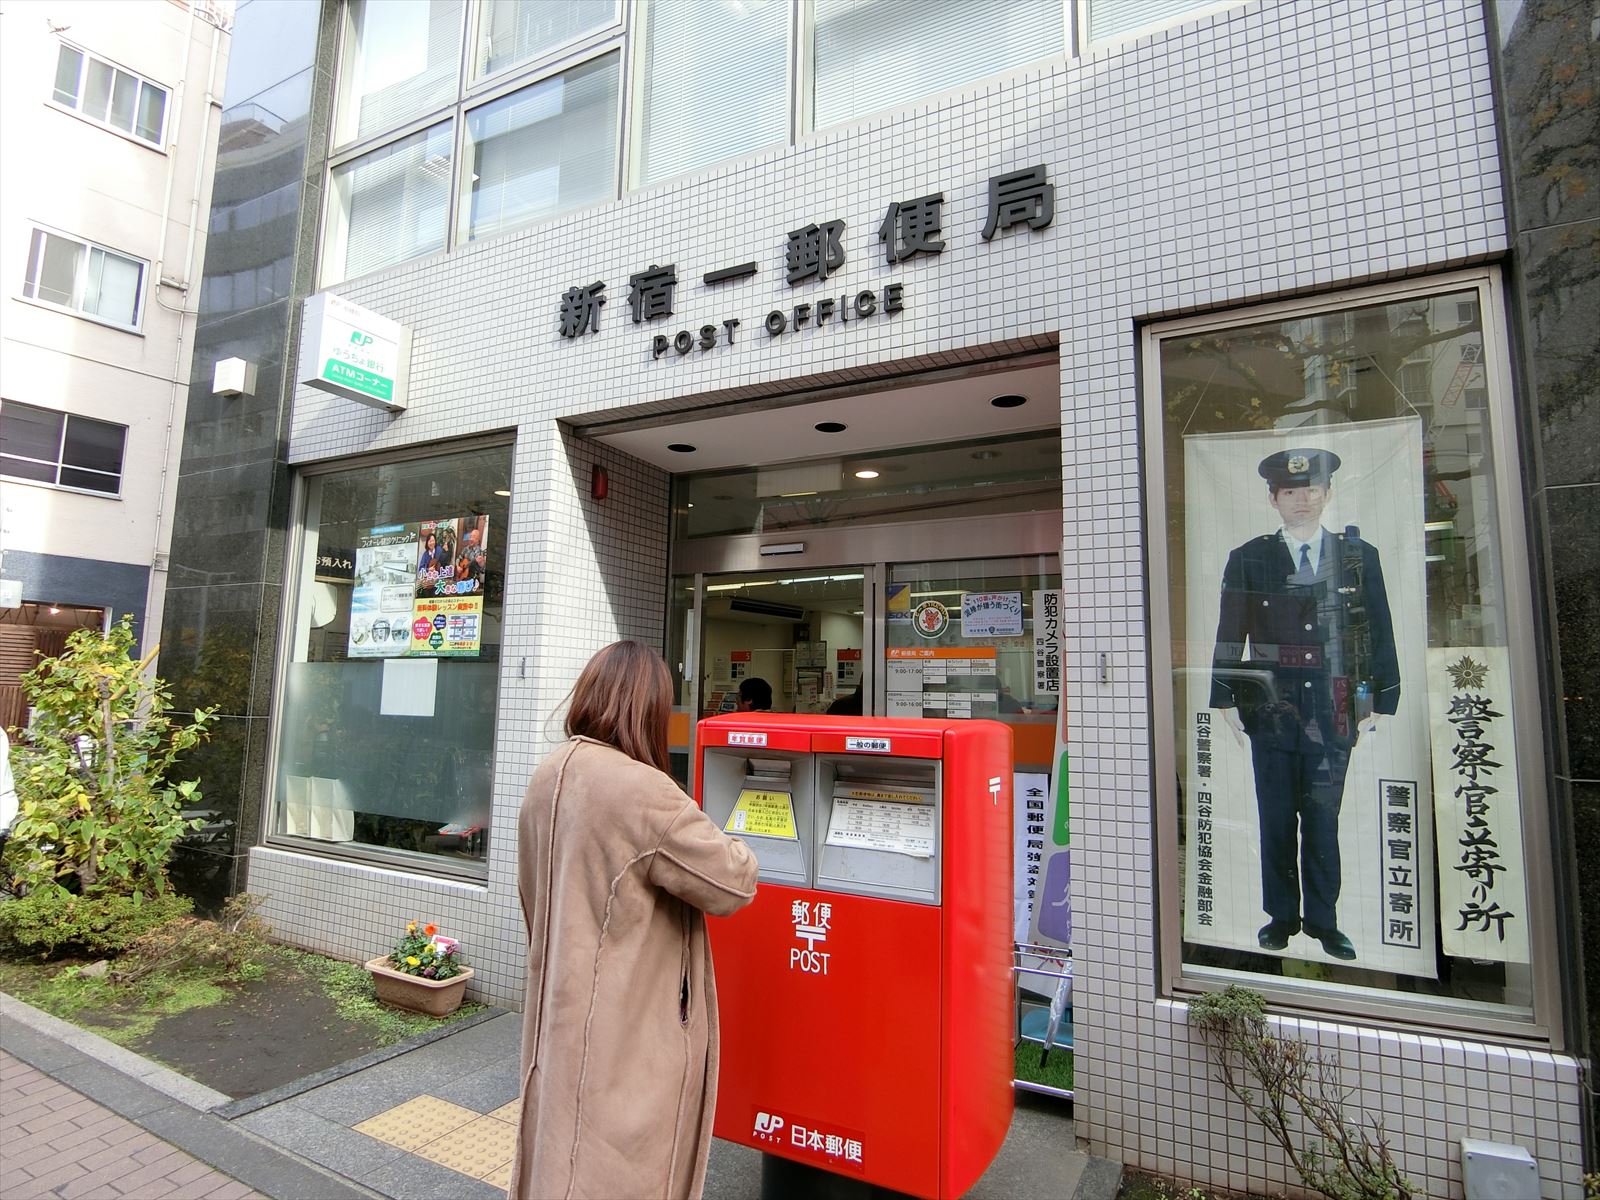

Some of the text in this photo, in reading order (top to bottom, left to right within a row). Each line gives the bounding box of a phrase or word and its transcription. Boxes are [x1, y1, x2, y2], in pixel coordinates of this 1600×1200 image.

[559, 163, 1056, 339] 新宿一郵便局
[652, 282, 905, 360] POST OFFICE
[331, 363, 389, 390] ATMコーナー
[333, 347, 385, 374] ゆうちょ銀行
[1044, 593, 1060, 691] 防犯カメラ設置店
[1036, 637, 1045, 690] 四谷警察署
[732, 736, 763, 744] 年賀郵便
[849, 741, 887, 750] 一般の郵便
[1196, 712, 1213, 927] 四谷警察署・四谷防犯協会金融部会
[1444, 694, 1516, 943] 警察官立寄り所
[1386, 785, 1413, 943] 警察官立寄所
[791, 900, 832, 929] 郵便
[790, 948, 831, 975] POST
[752, 1130, 782, 1144] POST
[754, 1111, 784, 1134] JP
[791, 1124, 862, 1163] 日本郵便
